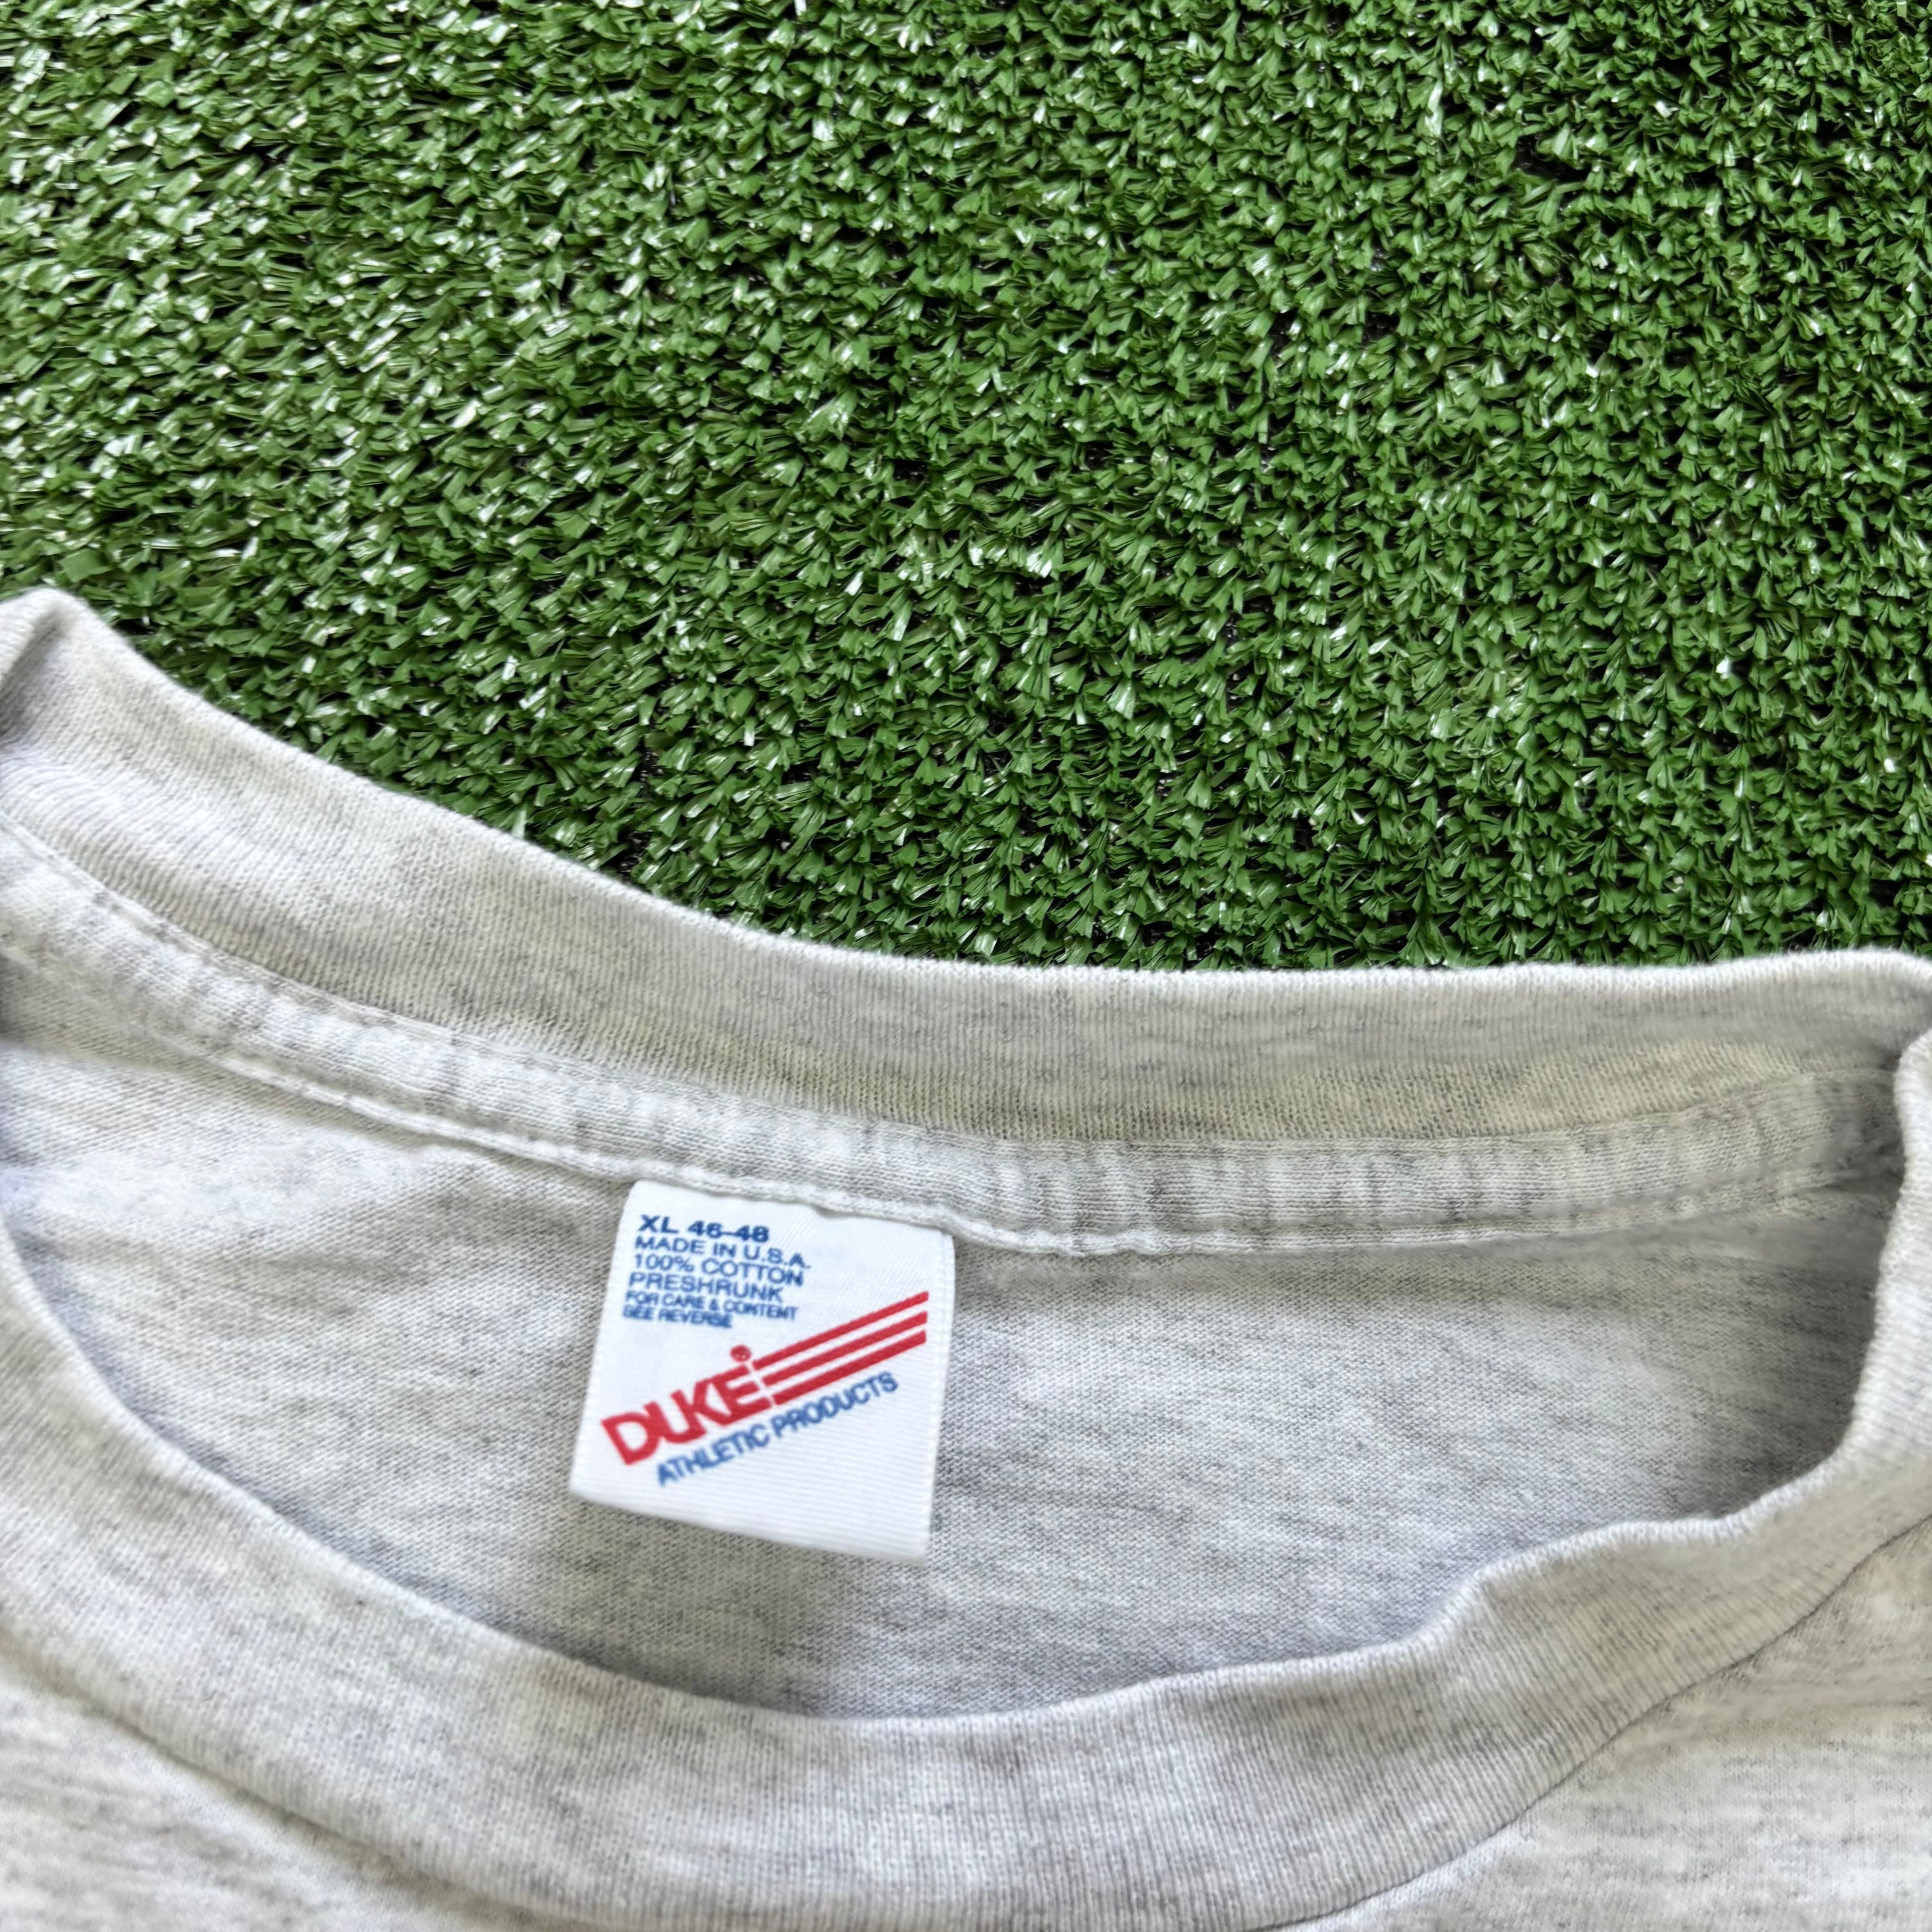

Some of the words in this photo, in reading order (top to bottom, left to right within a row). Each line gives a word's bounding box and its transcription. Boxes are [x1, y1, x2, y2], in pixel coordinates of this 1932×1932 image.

[638, 1214, 679, 1234] XL
[688, 1221, 769, 1242] 46-48
[635, 1236, 706, 1254] MADE
[713, 1243, 736, 1257] IN
[744, 1244, 811, 1269] U.S.A.
[635, 1253, 695, 1273] 100%
[702, 1258, 803, 1286] COTTON
[629, 1272, 783, 1303] PRESHRUNK
[622, 1305, 653, 1320] SEE
[659, 1308, 732, 1328] REVERSE
[626, 1291, 658, 1306] FOR
[662, 1293, 704, 1309] CARE
[708, 1299, 719, 1311] &
[724, 1299, 800, 1320] CONTENT
[601, 1363, 773, 1465] DUKE
[656, 1424, 772, 1487] ATHLETIC
[772, 1371, 899, 1439] PRODUCTS
